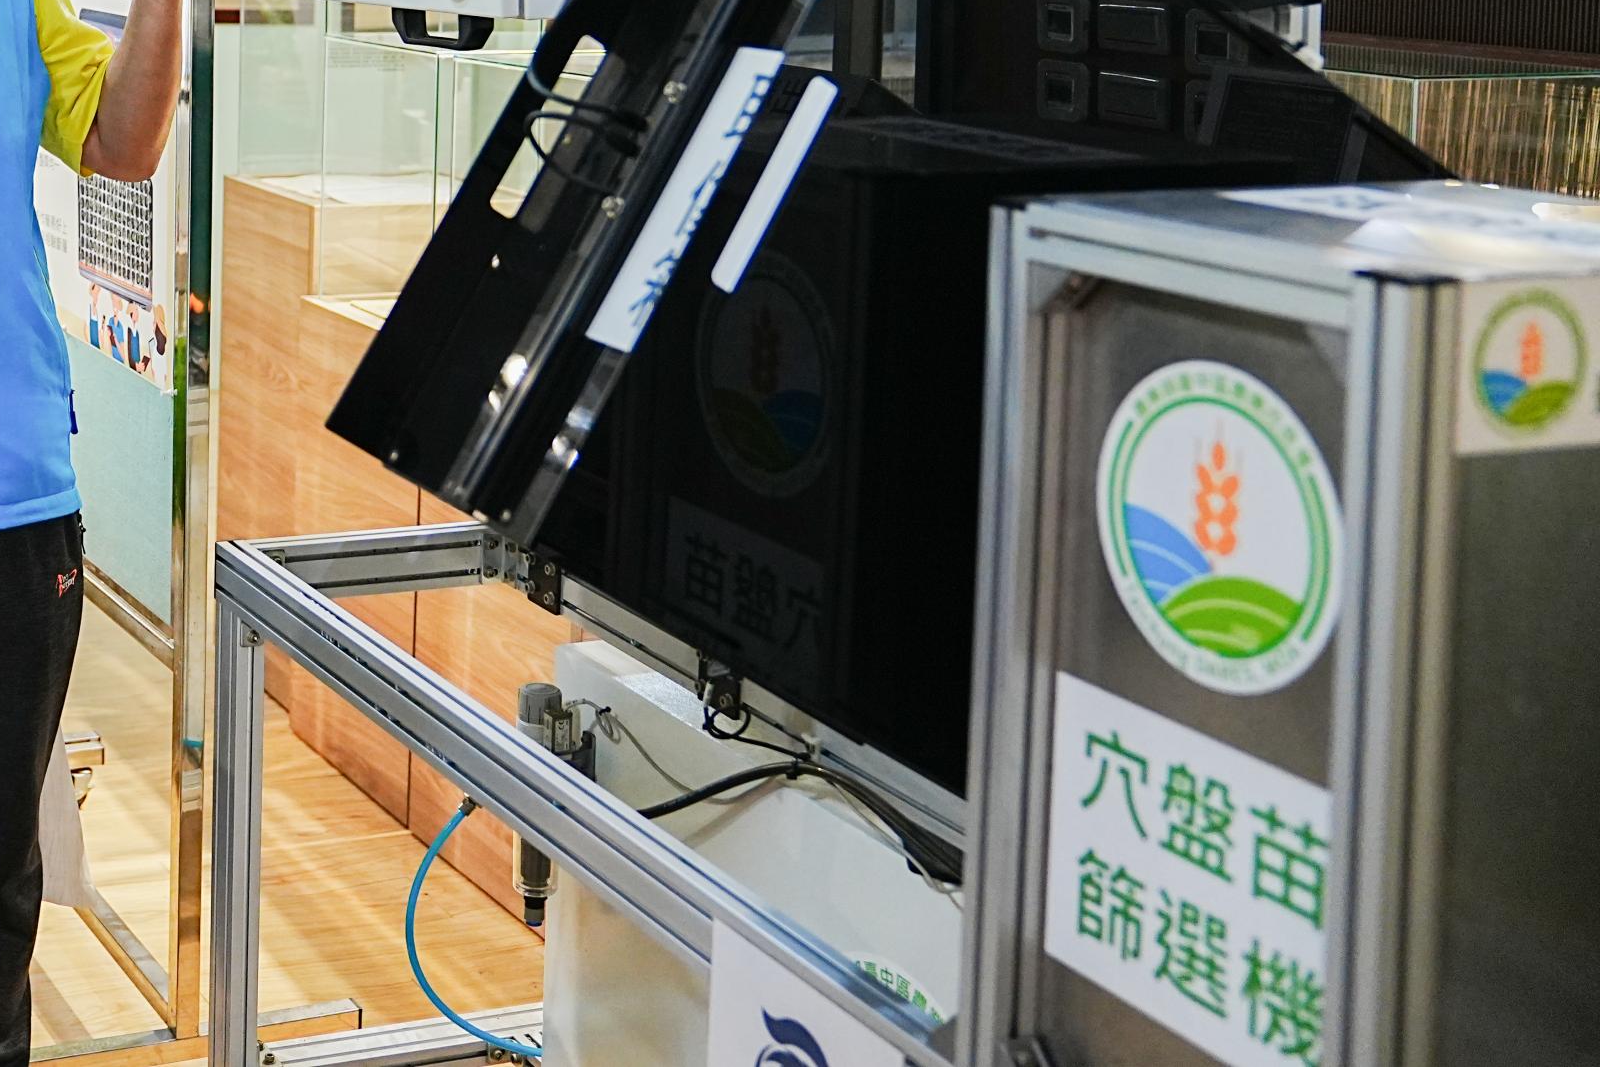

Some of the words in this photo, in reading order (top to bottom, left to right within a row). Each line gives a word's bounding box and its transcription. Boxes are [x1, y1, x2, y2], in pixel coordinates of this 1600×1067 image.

[1080, 730, 1329, 930] 穴盤苗
[1077, 848, 1322, 1067] 篩選機
